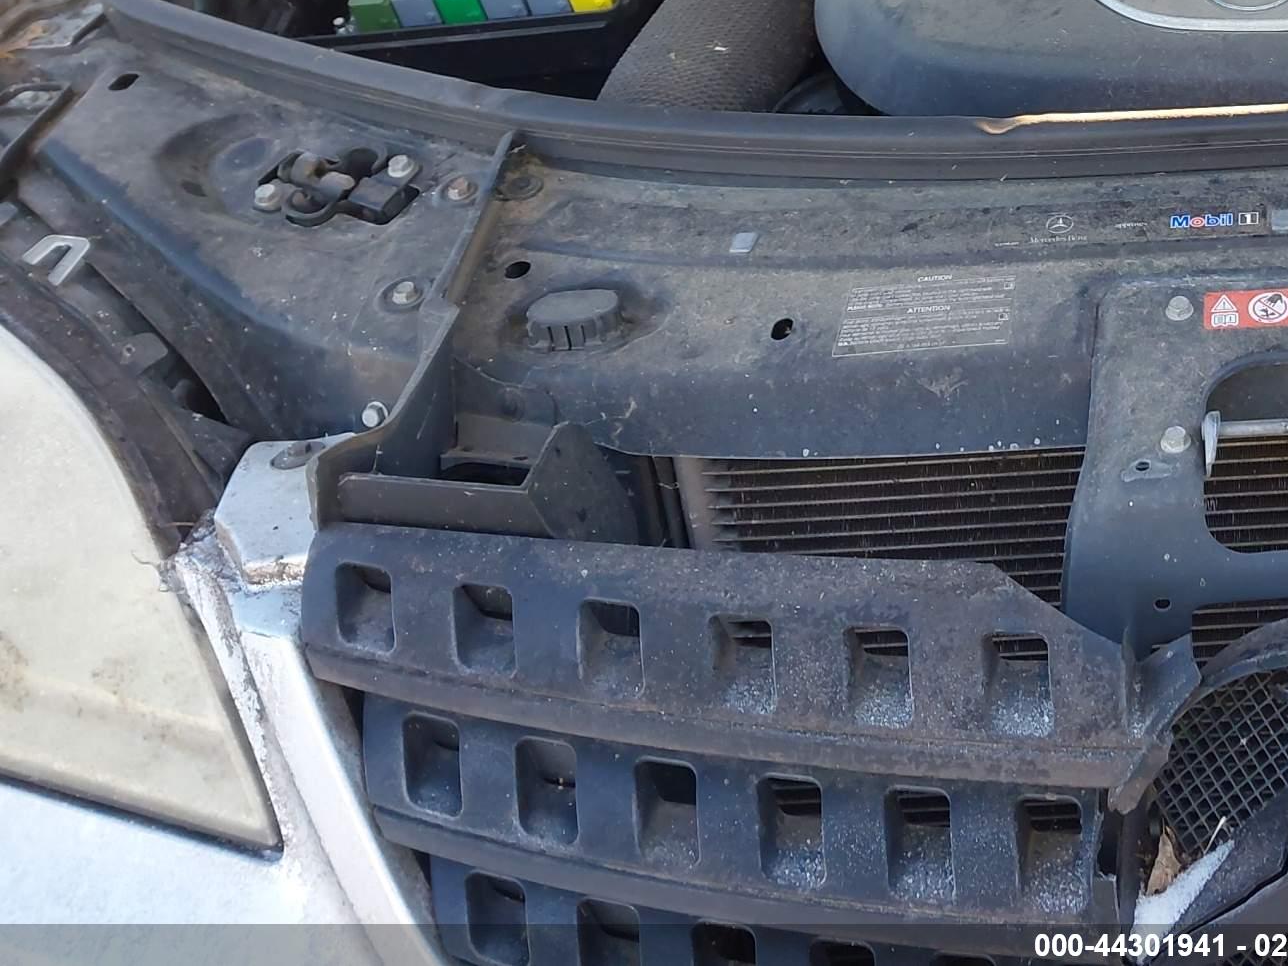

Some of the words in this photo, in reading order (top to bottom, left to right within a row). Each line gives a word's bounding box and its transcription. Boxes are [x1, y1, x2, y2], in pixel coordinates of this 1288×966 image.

[1170, 213, 1233, 228] Mobil
[917, 274, 953, 283] CAUTION
[906, 305, 951, 314] ATTENTION
